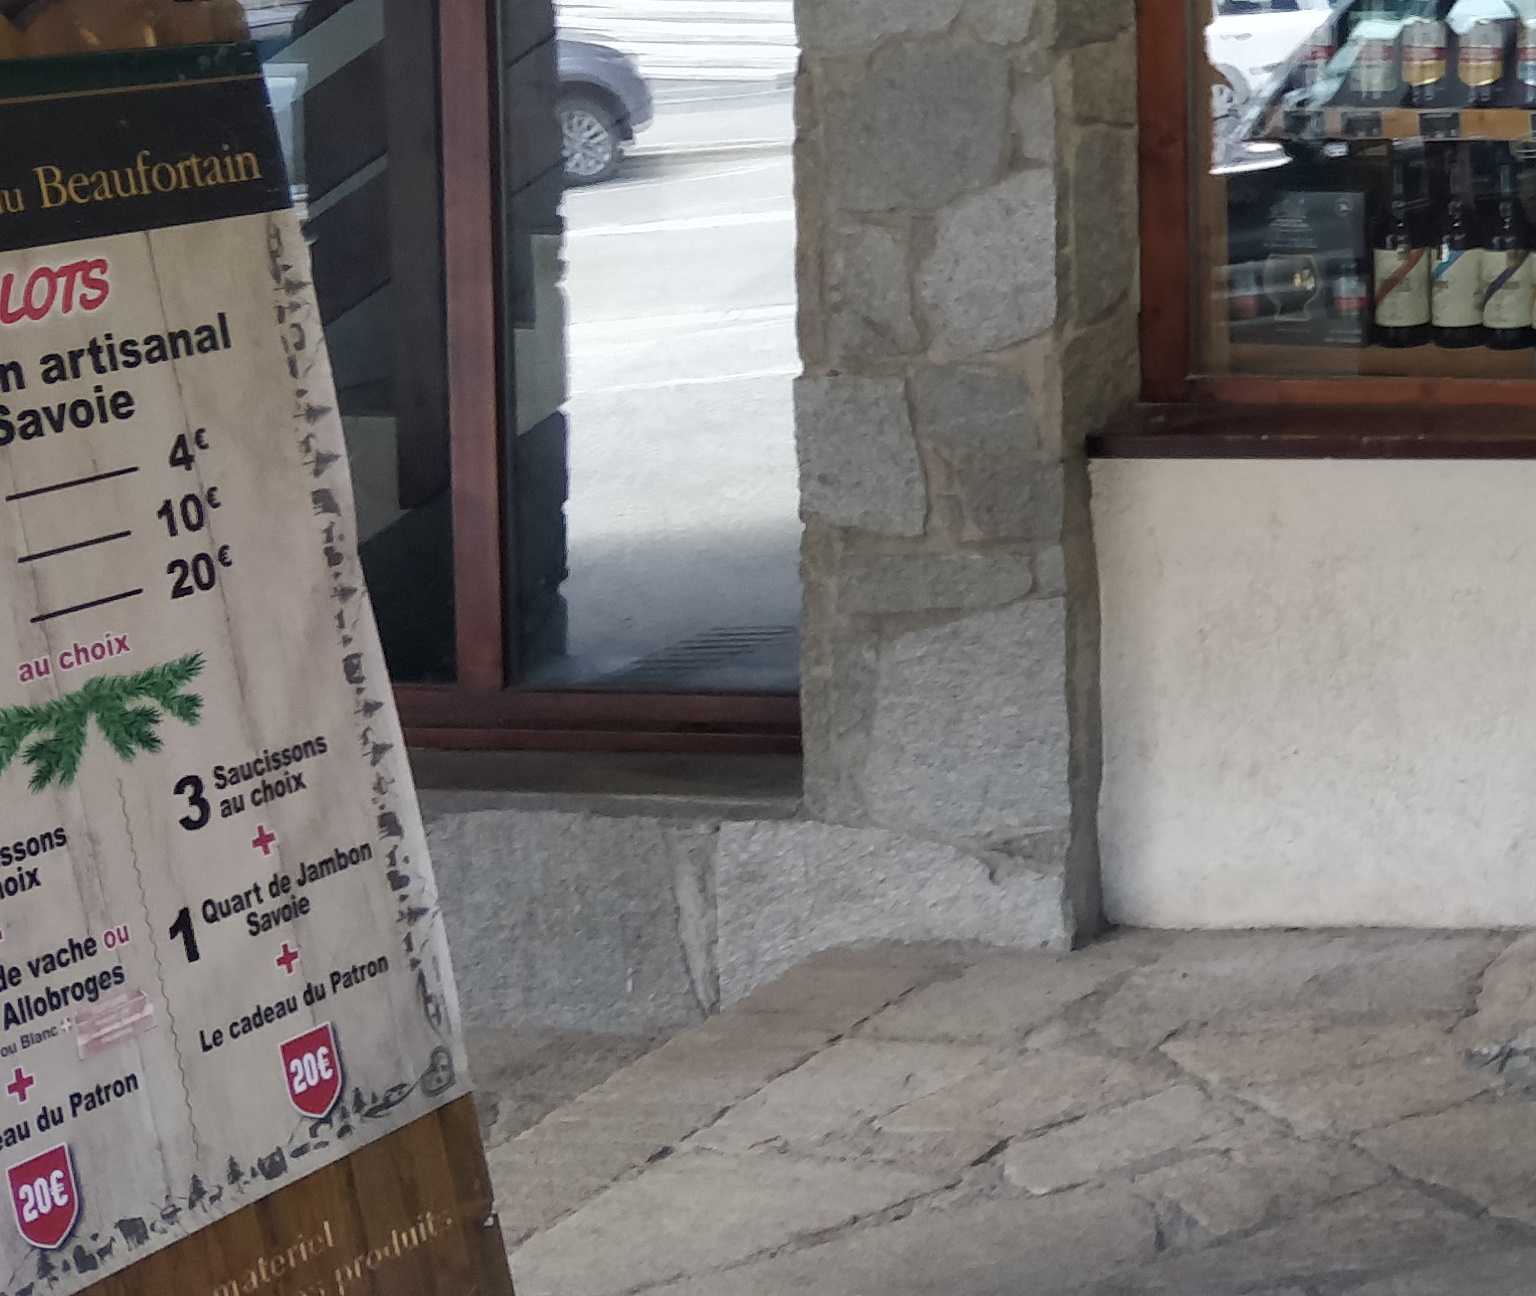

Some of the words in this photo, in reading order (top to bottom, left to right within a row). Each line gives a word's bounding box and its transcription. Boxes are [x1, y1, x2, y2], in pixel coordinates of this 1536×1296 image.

[0, 187, 25, 215] u
[32, 146, 263, 208] Beaufortain
[40, 312, 232, 385] artisanal
[169, 428, 209, 471] 4€
[156, 486, 222, 537] 10€
[167, 544, 232, 600] 20€
[18, 657, 51, 683] au
[58, 633, 131, 670] choix
[173, 774, 211, 831] 3
[213, 735, 328, 790] Saucissons
[220, 793, 245, 819] au
[251, 771, 307, 807] choix
[169, 906, 200, 963] 1
[202, 882, 265, 924] Quart
[269, 873, 292, 899] de
[297, 842, 373, 887] Jambon
[246, 894, 311, 937] Savoie
[28, 936, 97, 979] vache
[103, 925, 130, 949] ou
[3, 964, 125, 1031] Allobroges
[199, 1027, 224, 1052] Le
[229, 995, 298, 1039] cadeau
[303, 983, 326, 1007] du
[330, 955, 389, 993] Patron
[20, 1024, 58, 1050] Blanc
[290, 1045, 333, 1095] 20€
[37, 1106, 64, 1132] du
[69, 1073, 139, 1119] Patron
[19, 1169, 69, 1223] 20€
